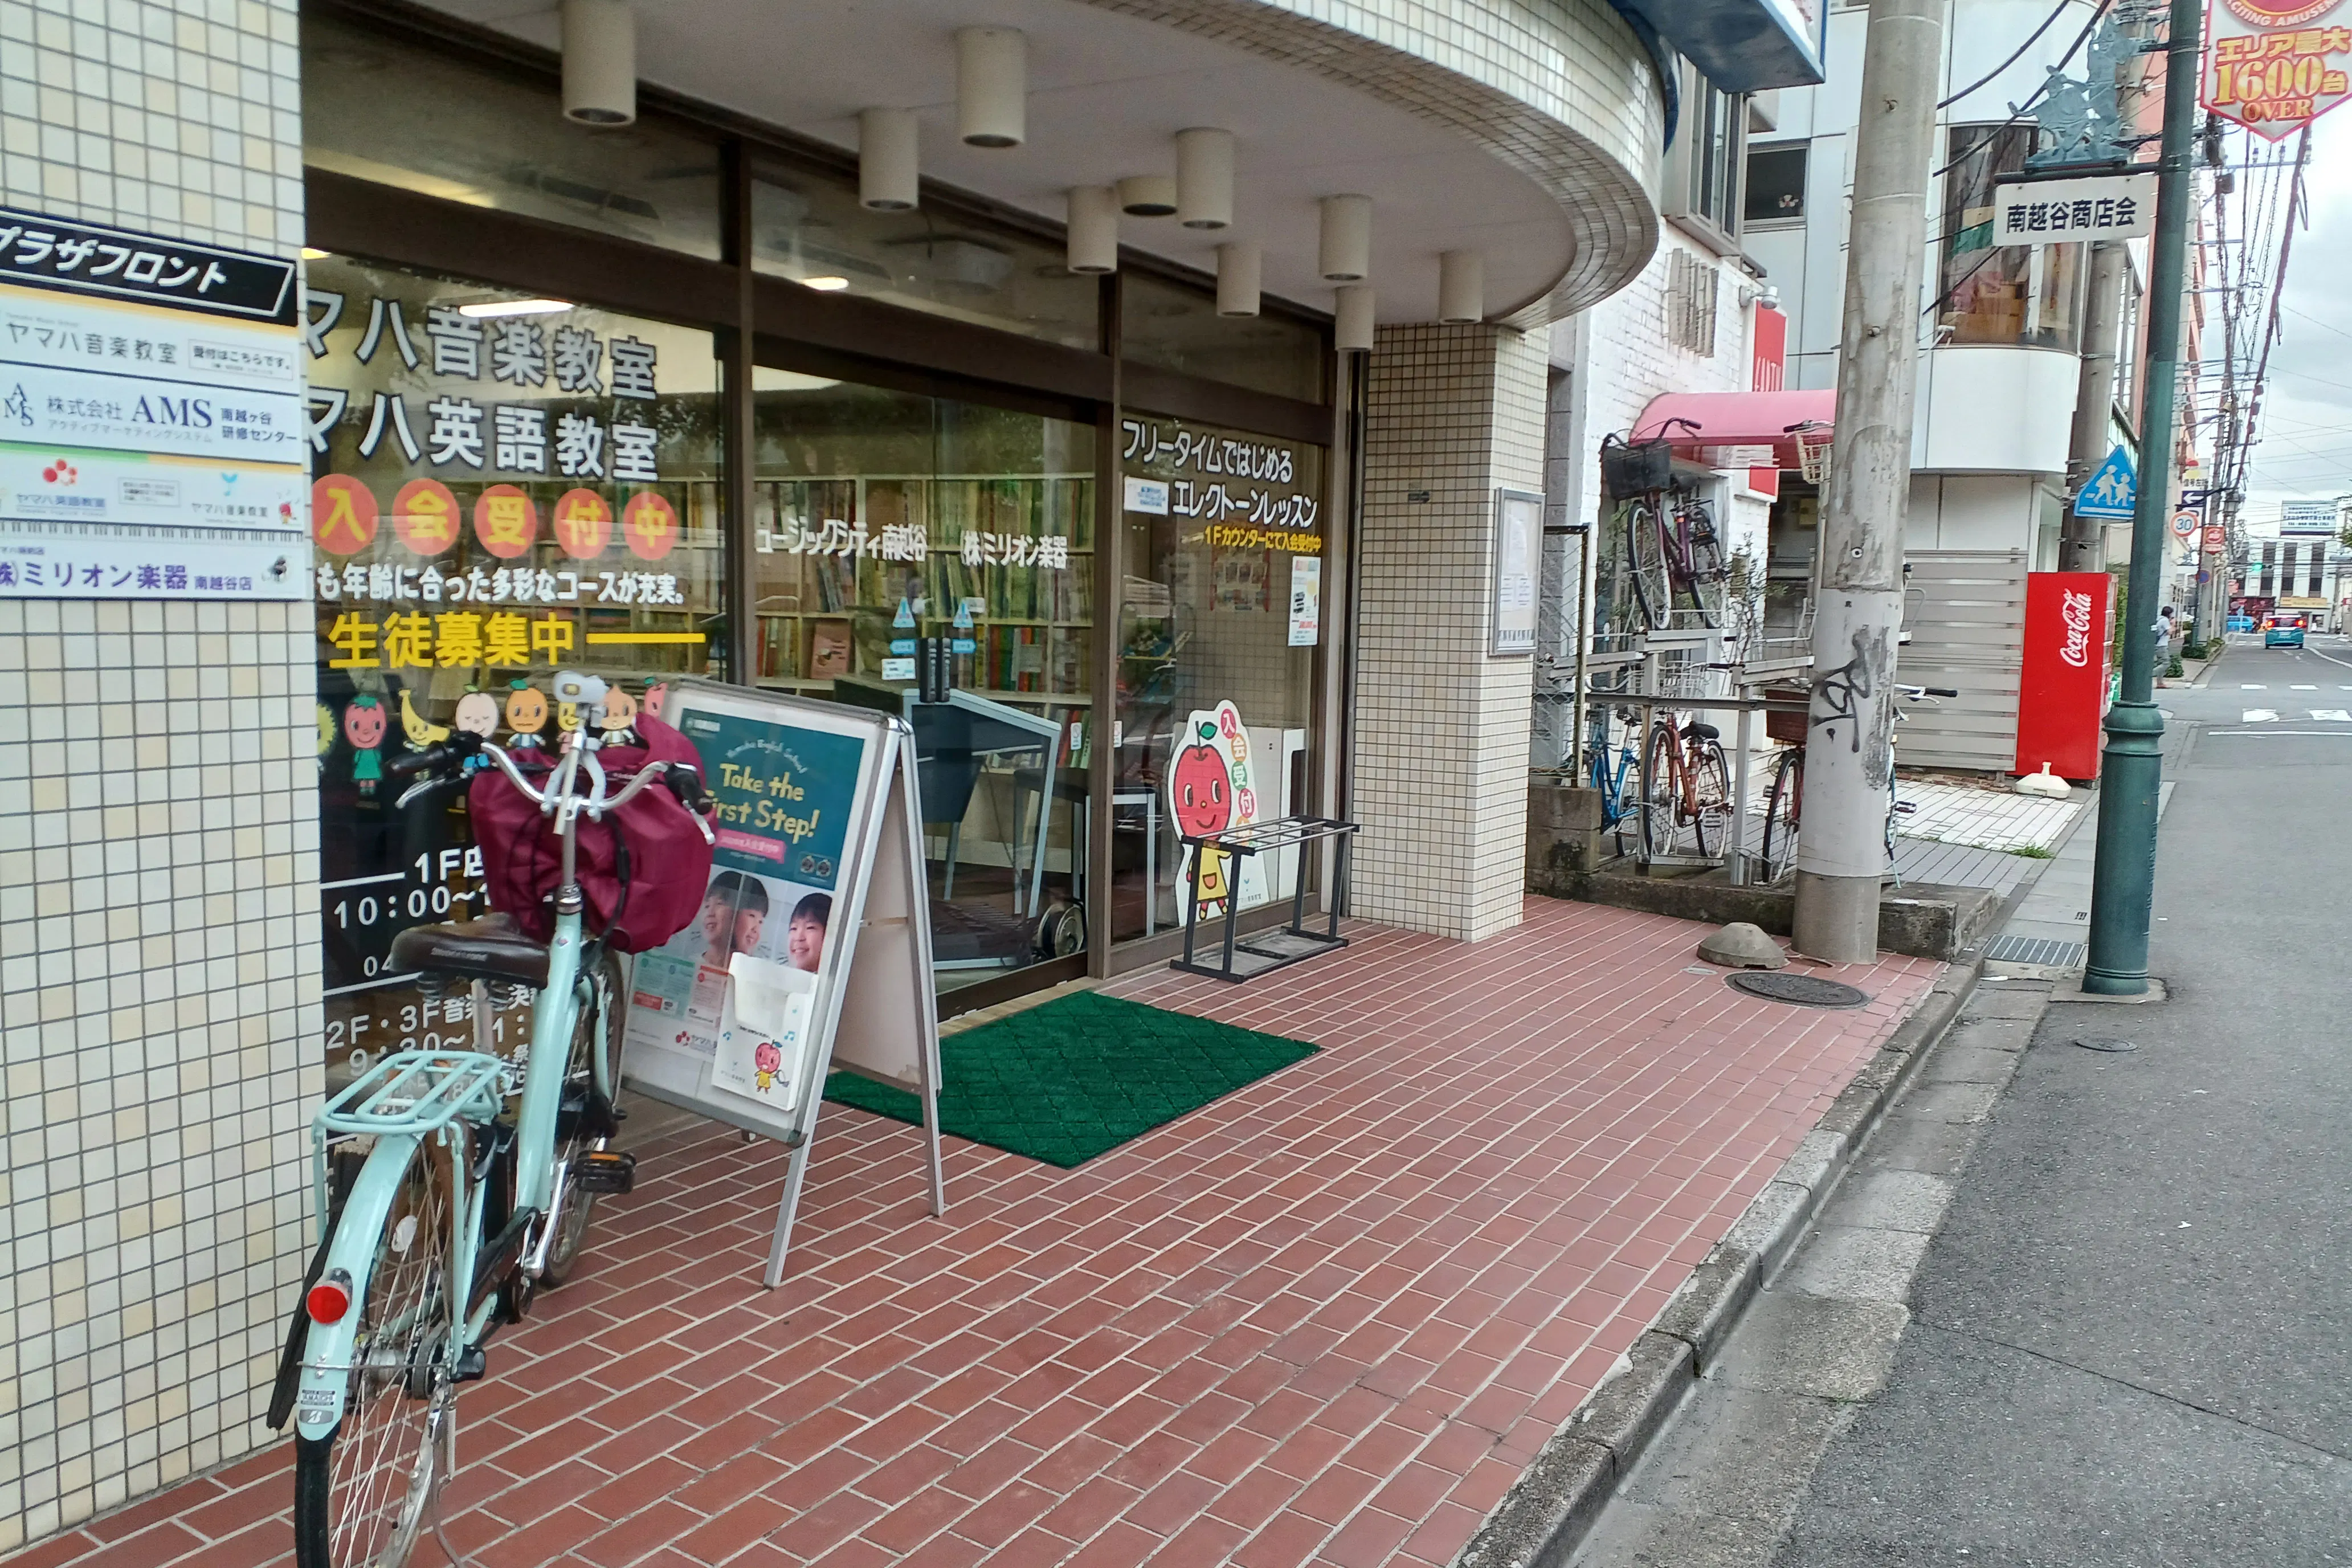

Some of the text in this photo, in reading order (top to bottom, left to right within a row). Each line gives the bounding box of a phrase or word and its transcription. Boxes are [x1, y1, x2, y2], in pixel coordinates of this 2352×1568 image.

[2216, 29, 2350, 62] エリア最大
[2244, 100, 2312, 121] OVER
[2007, 197, 2137, 234] 南越谷商店会
[6, 321, 177, 365] ヤマハ音楽教室
[47, 394, 213, 428] 株式会社 AMS
[1122, 420, 1292, 483] フリータイムではじめる
[318, 487, 668, 548] 入会受付中
[1173, 480, 1318, 528] エレクトーンレッスン
[1204, 524, 1322, 553] 1Fカウンターにて入会受付中
[2175, 518, 2192, 531] 30
[317, 562, 684, 605] も年齢に合った多彩なコースが充実。
[329, 611, 574, 669] 生徒募集中
[720, 763, 805, 801] Take the
[705, 790, 752, 824] rst
[755, 799, 820, 844] Step!
